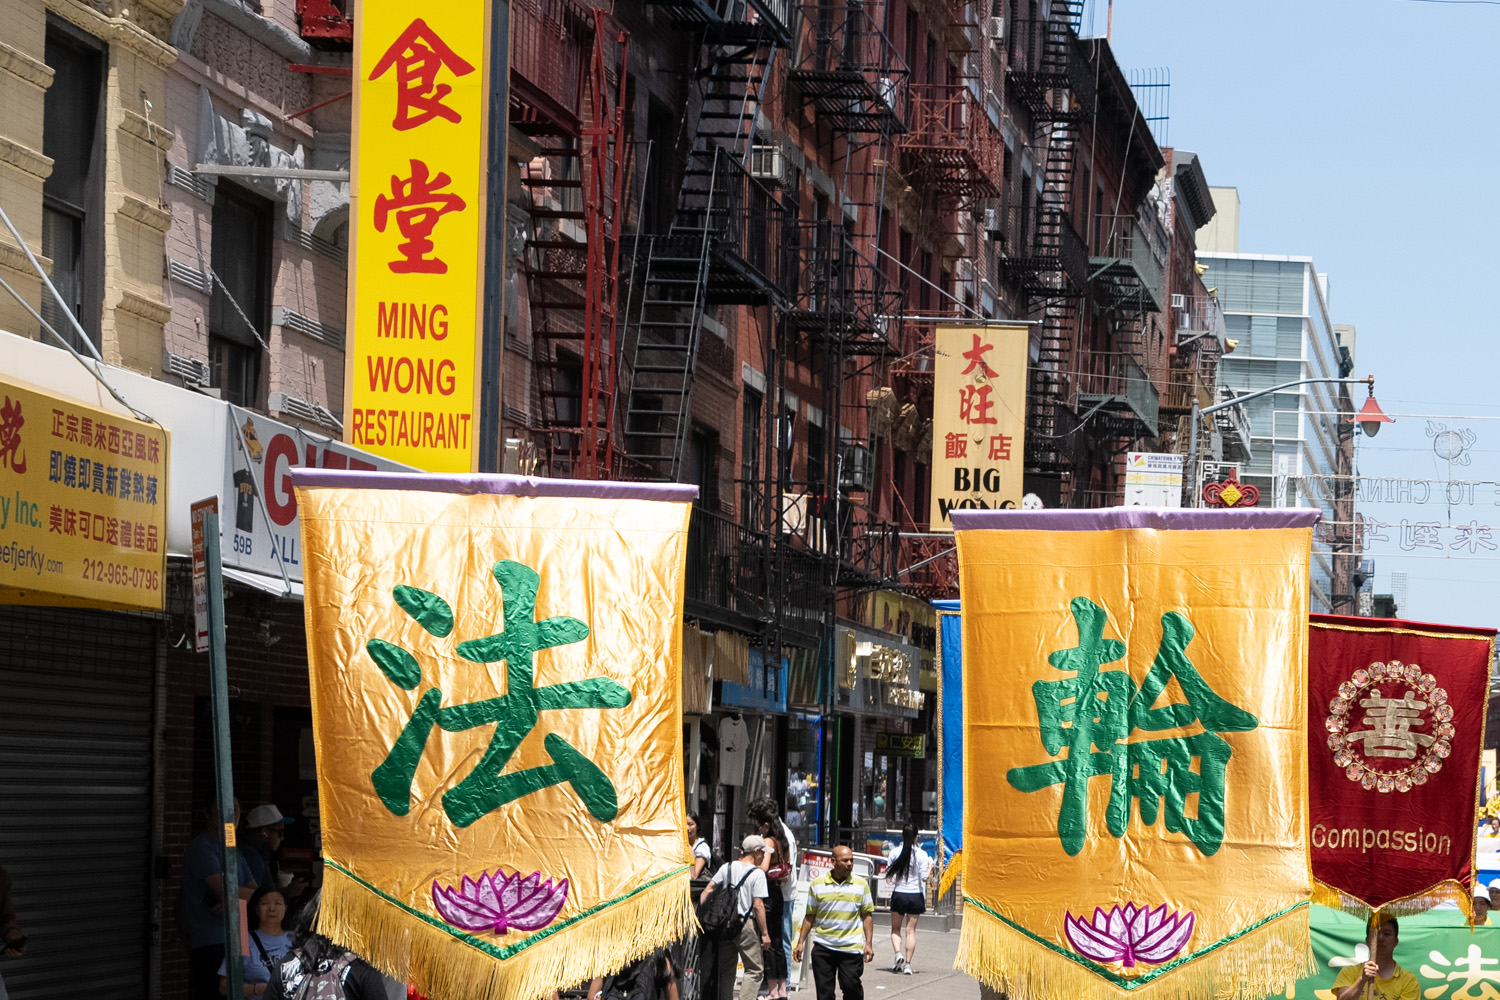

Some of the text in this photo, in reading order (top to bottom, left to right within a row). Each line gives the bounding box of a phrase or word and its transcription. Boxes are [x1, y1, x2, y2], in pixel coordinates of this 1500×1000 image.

[368, 18, 475, 275] 食堂
[377, 303, 449, 341] MING
[367, 356, 456, 396] WONG
[959, 333, 999, 425] 大旺
[51, 408, 160, 464] 正宗馬來西亞風味
[352, 408, 471, 450] RESTAURANT
[944, 432, 1013, 461] 飯店
[953, 467, 1000, 493] BIG
[15, 491, 42, 528] Inc.
[49, 504, 158, 553] 美味可口送禮佳品
[233, 534, 252, 555] 59B
[270, 534, 299, 565] ALL
[82, 557, 159, 591] 212-965-0796
[367, 559, 633, 829] 法
[1007, 596, 1259, 857] 輪
[1346, 689, 1433, 760] 善
[1311, 823, 1452, 855] Compassion
